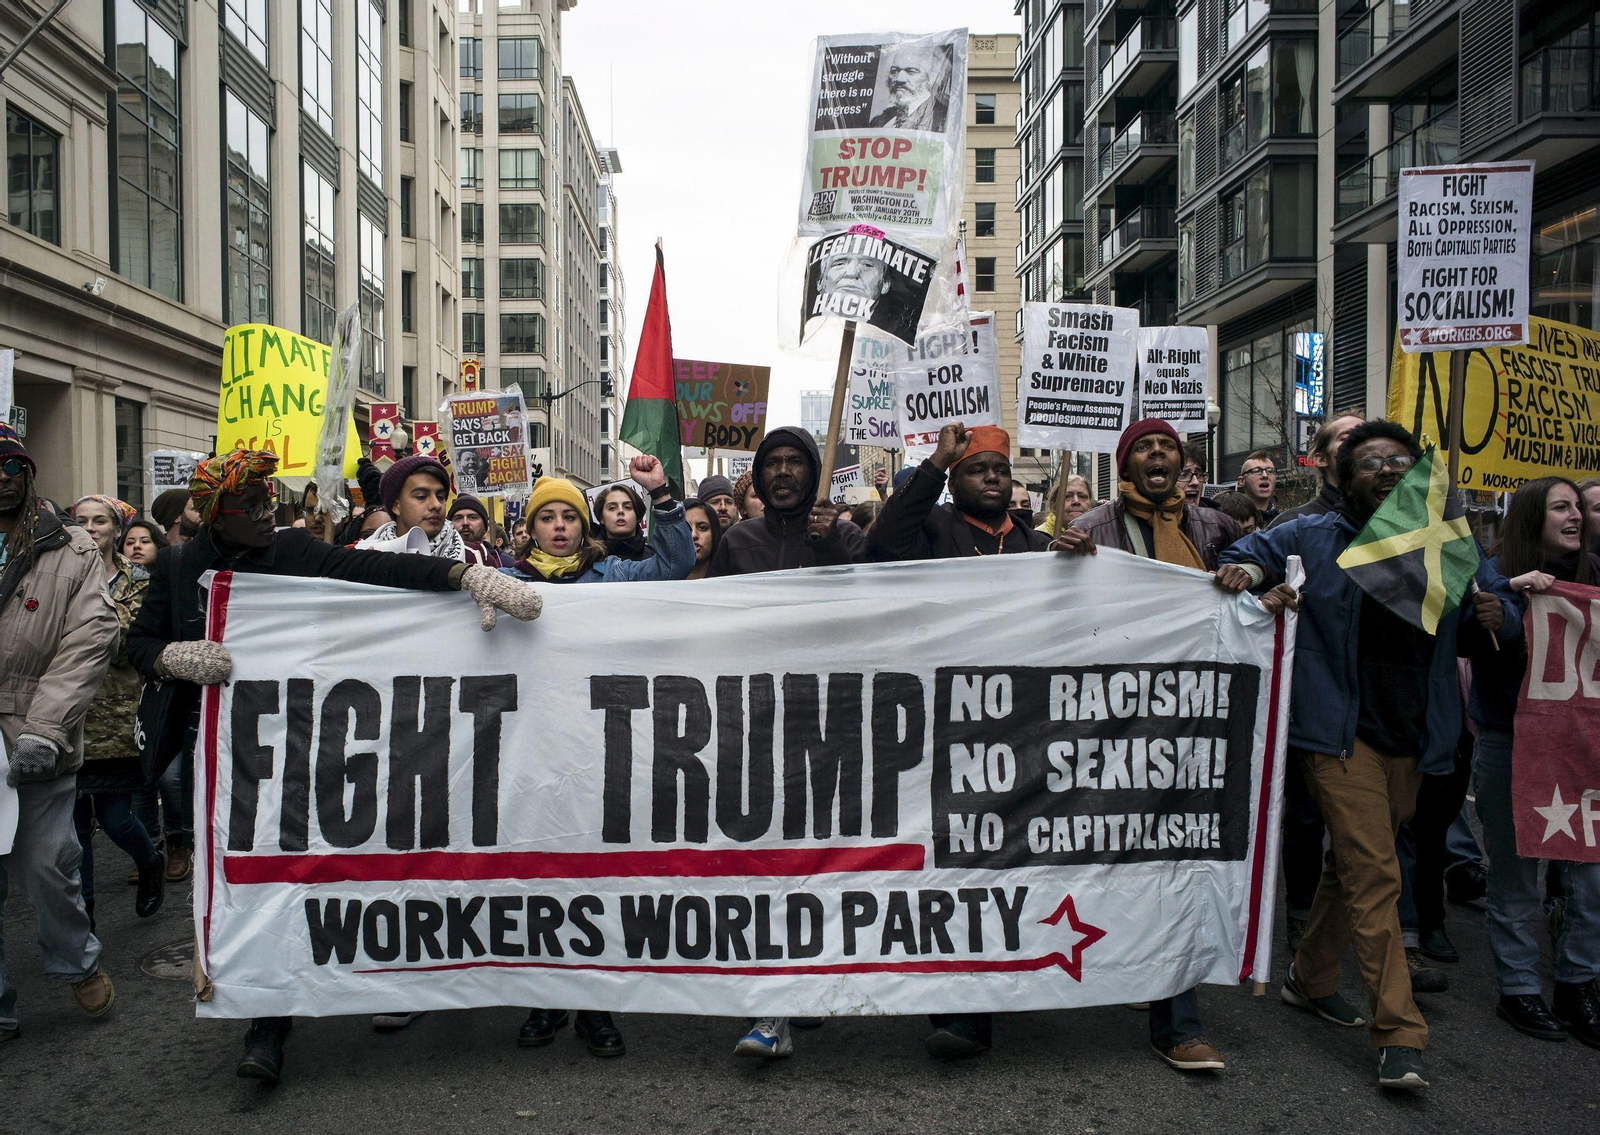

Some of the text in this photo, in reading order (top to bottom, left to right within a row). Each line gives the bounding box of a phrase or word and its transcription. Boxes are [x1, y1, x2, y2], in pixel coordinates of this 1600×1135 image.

[822, 69, 864, 83] struggle
[820, 87, 873, 100] there is no
[839, 137, 913, 161] STOP
[819, 165, 928, 192] TRUMP!
[1442, 174, 1488, 198] FIGHT
[811, 203, 834, 215] RESIST
[850, 195, 902, 208] WASHINGTON
[902, 199, 918, 209] D.C.
[853, 205, 920, 217] FRIDAY JANUARY 20TH
[847, 212, 879, 221] Asembly
[1421, 266, 1498, 288] FIGHT FOR
[812, 292, 876, 321] HACK
[1404, 288, 1516, 322] SOCIALISM!
[1048, 307, 1114, 331] Smash
[1047, 330, 1109, 353] Facism
[1427, 326, 1513, 343] WORKERS.ORG
[1041, 351, 1109, 374] & White
[1147, 348, 1202, 366] Alt-Right
[1501, 349, 1565, 387] FASCIST
[675, 359, 720, 380] EEP
[927, 363, 963, 386] FOR
[1156, 367, 1190, 379] equals
[1310, 332, 1324, 413] welcome
[1030, 371, 1125, 397] Supremacy
[1144, 379, 1203, 395] Neo Nazis
[224, 383, 326, 423] CHANG
[451, 400, 496, 415] TRUMP
[905, 385, 990, 422] SOCIALISM
[1028, 400, 1122, 415] People's Power Assembly
[1142, 401, 1206, 410] People's Power Assembly
[1507, 378, 1593, 422] RACISM
[731, 401, 767, 424] OFF
[854, 412, 863, 425] IS
[1029, 411, 1118, 428] peoplespower.net
[1144, 410, 1202, 420] peoplespower.net
[453, 418, 481, 431] SAYS
[704, 421, 759, 449] BODY
[849, 427, 867, 441] THE
[1506, 411, 1565, 442] POLICE
[454, 430, 511, 445] GET BACK
[503, 443, 525, 457] SAY
[1503, 437, 1563, 468] MUSLIM
[1564, 448, 1573, 469] &
[491, 457, 525, 470] FIGHT
[489, 469, 526, 484] BACK!
[831, 471, 858, 485] FIGHT!
[949, 670, 1232, 722] NO RACISM!
[227, 674, 519, 851] FIGHT
[588, 672, 926, 844] TRUMP
[949, 737, 1229, 794] NO SEXISM!
[948, 812, 1221, 854] NO CAPITALISM!
[305, 886, 1029, 966] WORKERS WORLD PARTY
